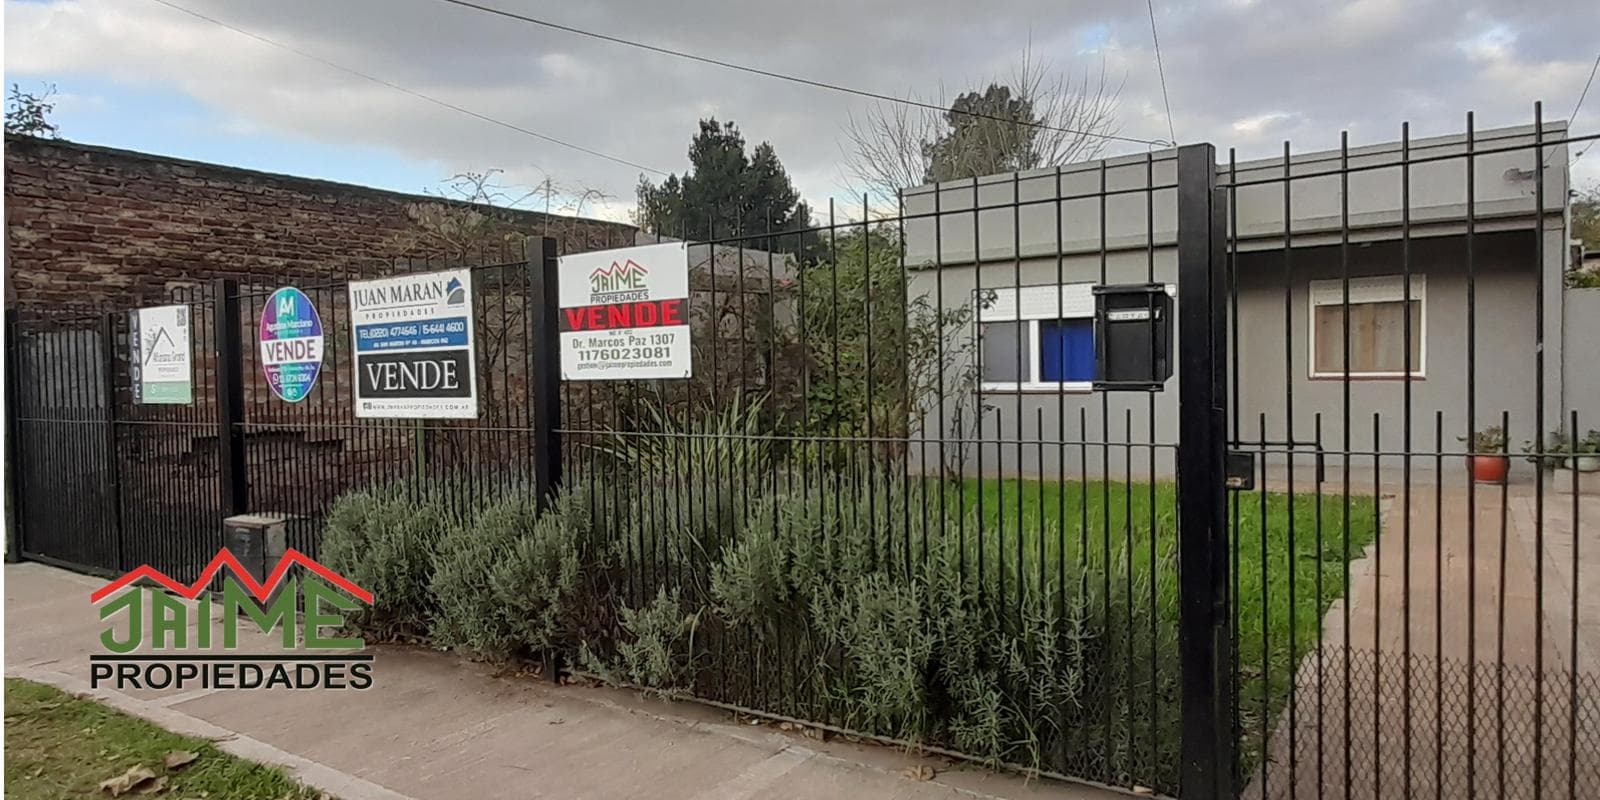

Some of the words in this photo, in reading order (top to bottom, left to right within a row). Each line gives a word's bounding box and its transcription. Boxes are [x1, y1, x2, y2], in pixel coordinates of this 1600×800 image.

[590, 267, 647, 293] JAIME
[353, 287, 386, 311] JUAN
[390, 281, 443, 303] MARAN
[590, 291, 649, 304] PROPIEDADES
[365, 307, 435, 320] PROPIEDADES
[565, 299, 683, 330] VENDE
[265, 339, 316, 362] VENDE
[572, 338, 586, 349] Dr.
[588, 337, 626, 348] Marcos
[628, 335, 647, 346] Paz
[650, 333, 675, 345] 1307
[130, 312, 141, 399] VENDE
[578, 347, 671, 361] 1176023081
[366, 360, 459, 391] VENDE
